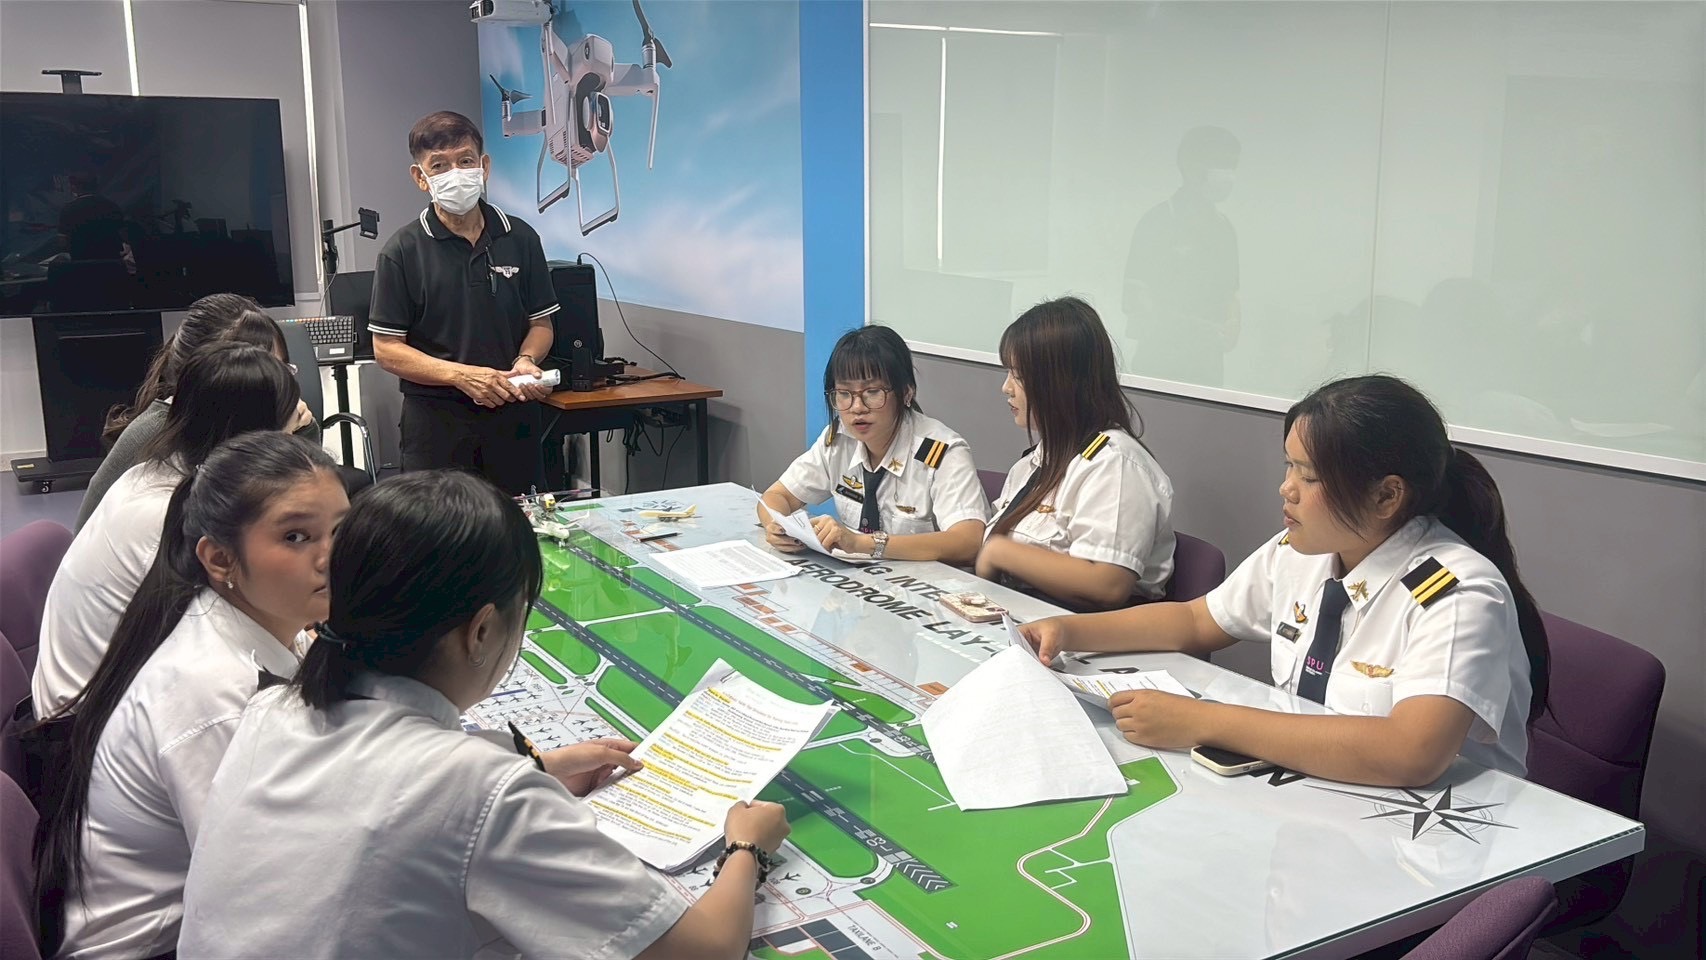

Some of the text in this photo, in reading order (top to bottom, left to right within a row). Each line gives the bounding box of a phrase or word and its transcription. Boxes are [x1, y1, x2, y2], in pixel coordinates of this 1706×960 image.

[884, 575, 947, 602] INTE
[784, 559, 933, 620] AERODROME
[922, 620, 1001, 657] LAY-
[1306, 656, 1325, 671] SPU
[847, 924, 876, 947] TAXILANE
